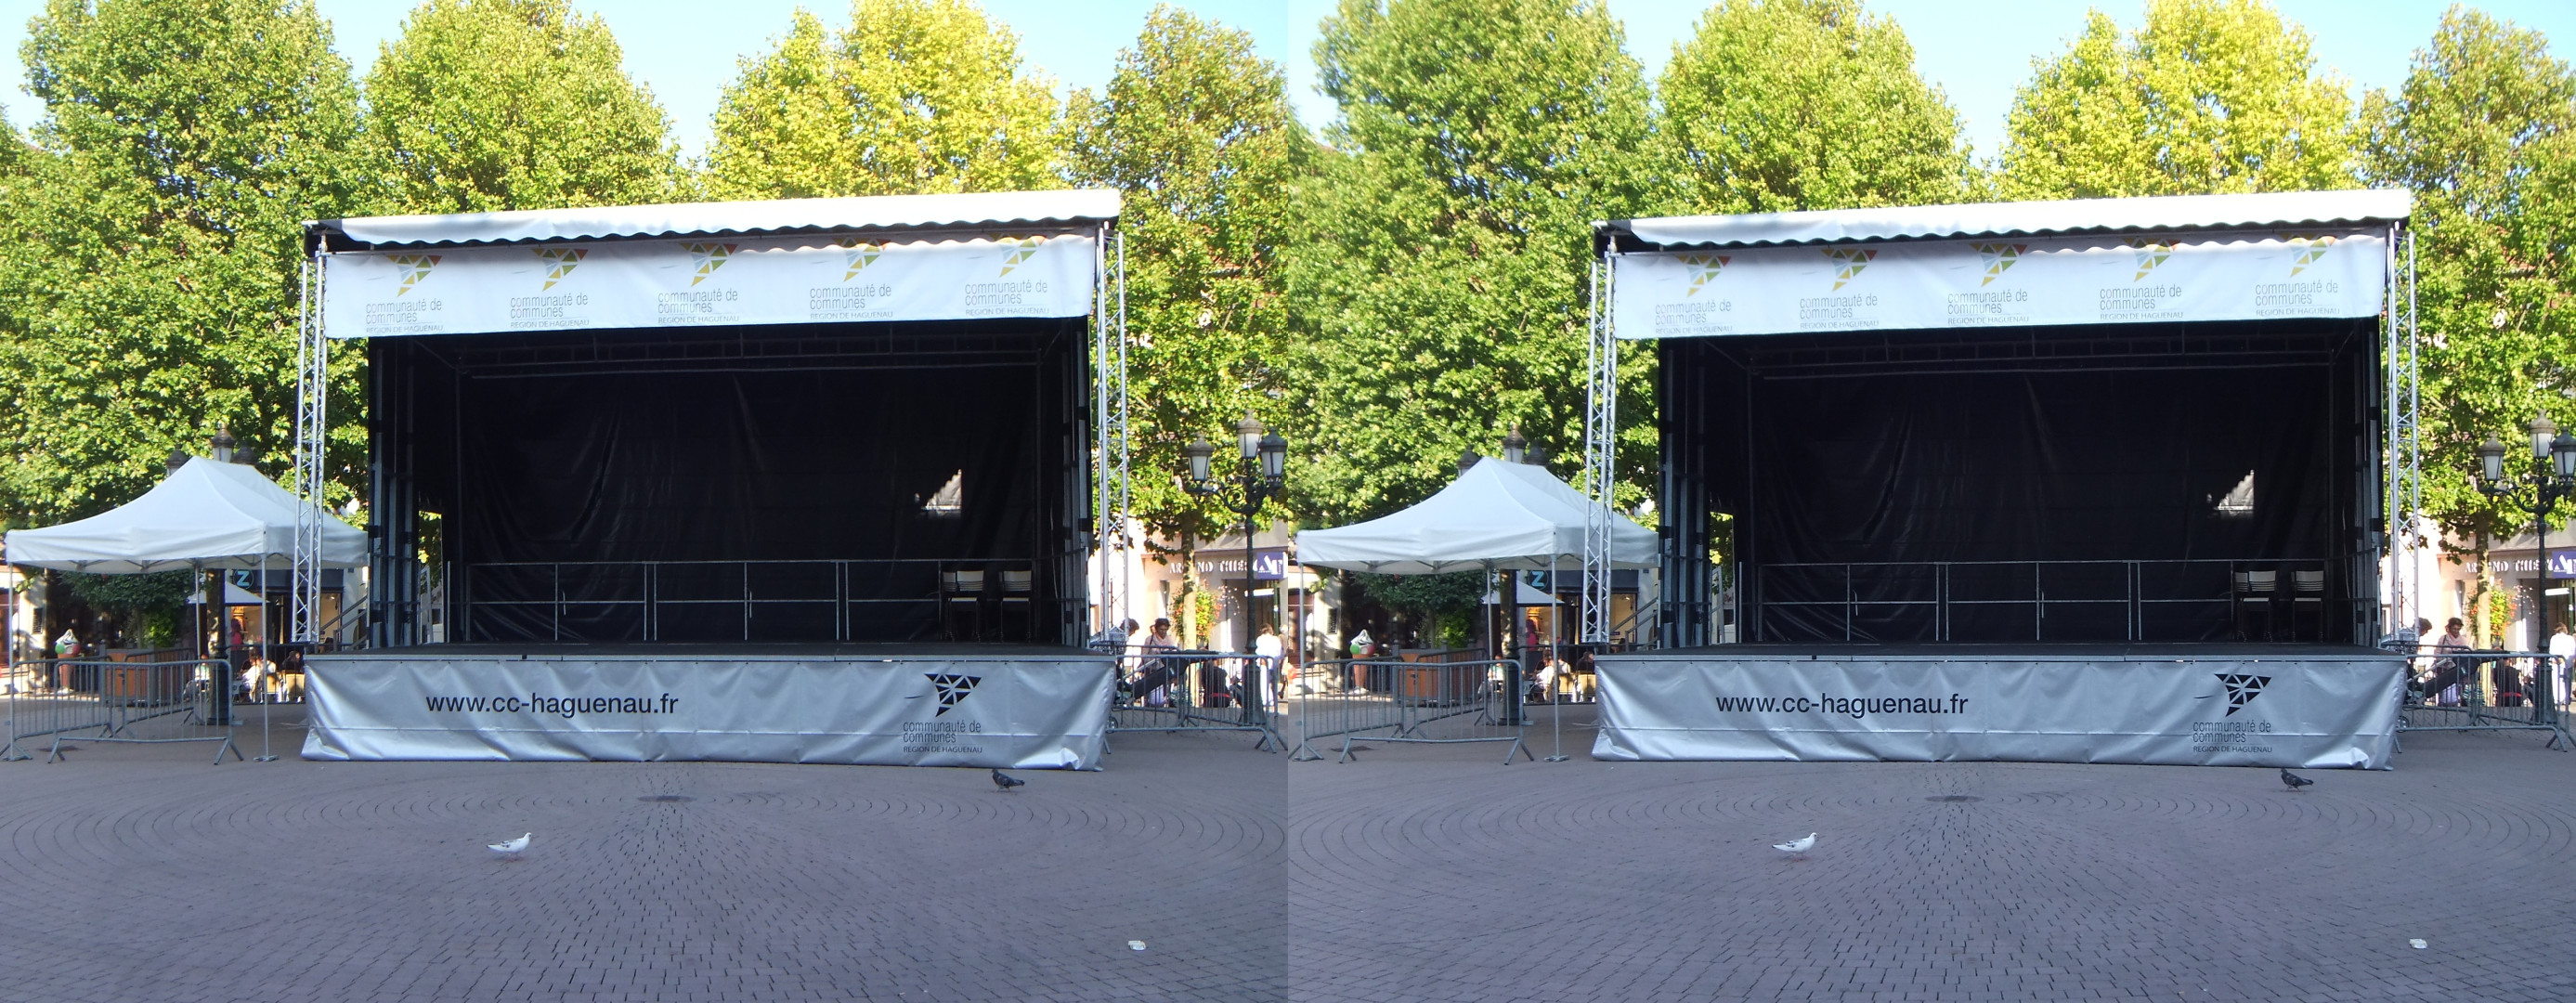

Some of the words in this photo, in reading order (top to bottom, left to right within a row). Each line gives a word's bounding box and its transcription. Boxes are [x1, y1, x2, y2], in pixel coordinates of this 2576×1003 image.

[810, 284, 875, 298] communauté
[879, 284, 891, 296] de
[965, 280, 1031, 294] communauté
[1036, 280, 1047, 293] de
[2101, 285, 2166, 299] communauté
[2169, 284, 2181, 297] de
[2256, 280, 2322, 294] communauté
[2326, 280, 2338, 293] de
[511, 293, 572, 307] communauté
[577, 293, 588, 306] de
[658, 288, 722, 303] communauté
[726, 288, 737, 301] de
[966, 293, 1021, 306] communes
[1800, 293, 1862, 308] communauté
[1866, 293, 1878, 306] de
[1948, 289, 2011, 303] communauté
[2016, 289, 2027, 301] de
[2256, 293, 2312, 306] communes
[366, 299, 425, 313] communauté
[430, 299, 442, 311] de
[658, 303, 712, 314] communes
[810, 298, 865, 309] communes
[1656, 299, 1715, 314] communauté
[1720, 299, 1731, 311] de
[1948, 303, 2002, 314] communes
[2101, 299, 2155, 310] communes
[366, 312, 417, 324] communes
[511, 306, 563, 319] communes
[1656, 313, 1707, 325] communes
[1800, 307, 1853, 319] communes
[1169, 561, 1214, 573] ARND
[1217, 559, 1258, 572] THIEY
[2465, 561, 2509, 573] ARND
[2513, 558, 2553, 571] THIEY
[237, 571, 249, 586] Z
[1531, 571, 1544, 586] Z
[426, 693, 679, 719] www.cc-haguenau.fr
[1716, 693, 1969, 719] www.cc-haguenau.fr
[903, 720, 966, 733] communauté
[969, 721, 981, 733] de
[2192, 720, 2256, 733] communauté
[2259, 720, 2271, 733] de
[903, 733, 956, 743] communes
[2192, 733, 2246, 743] communes
